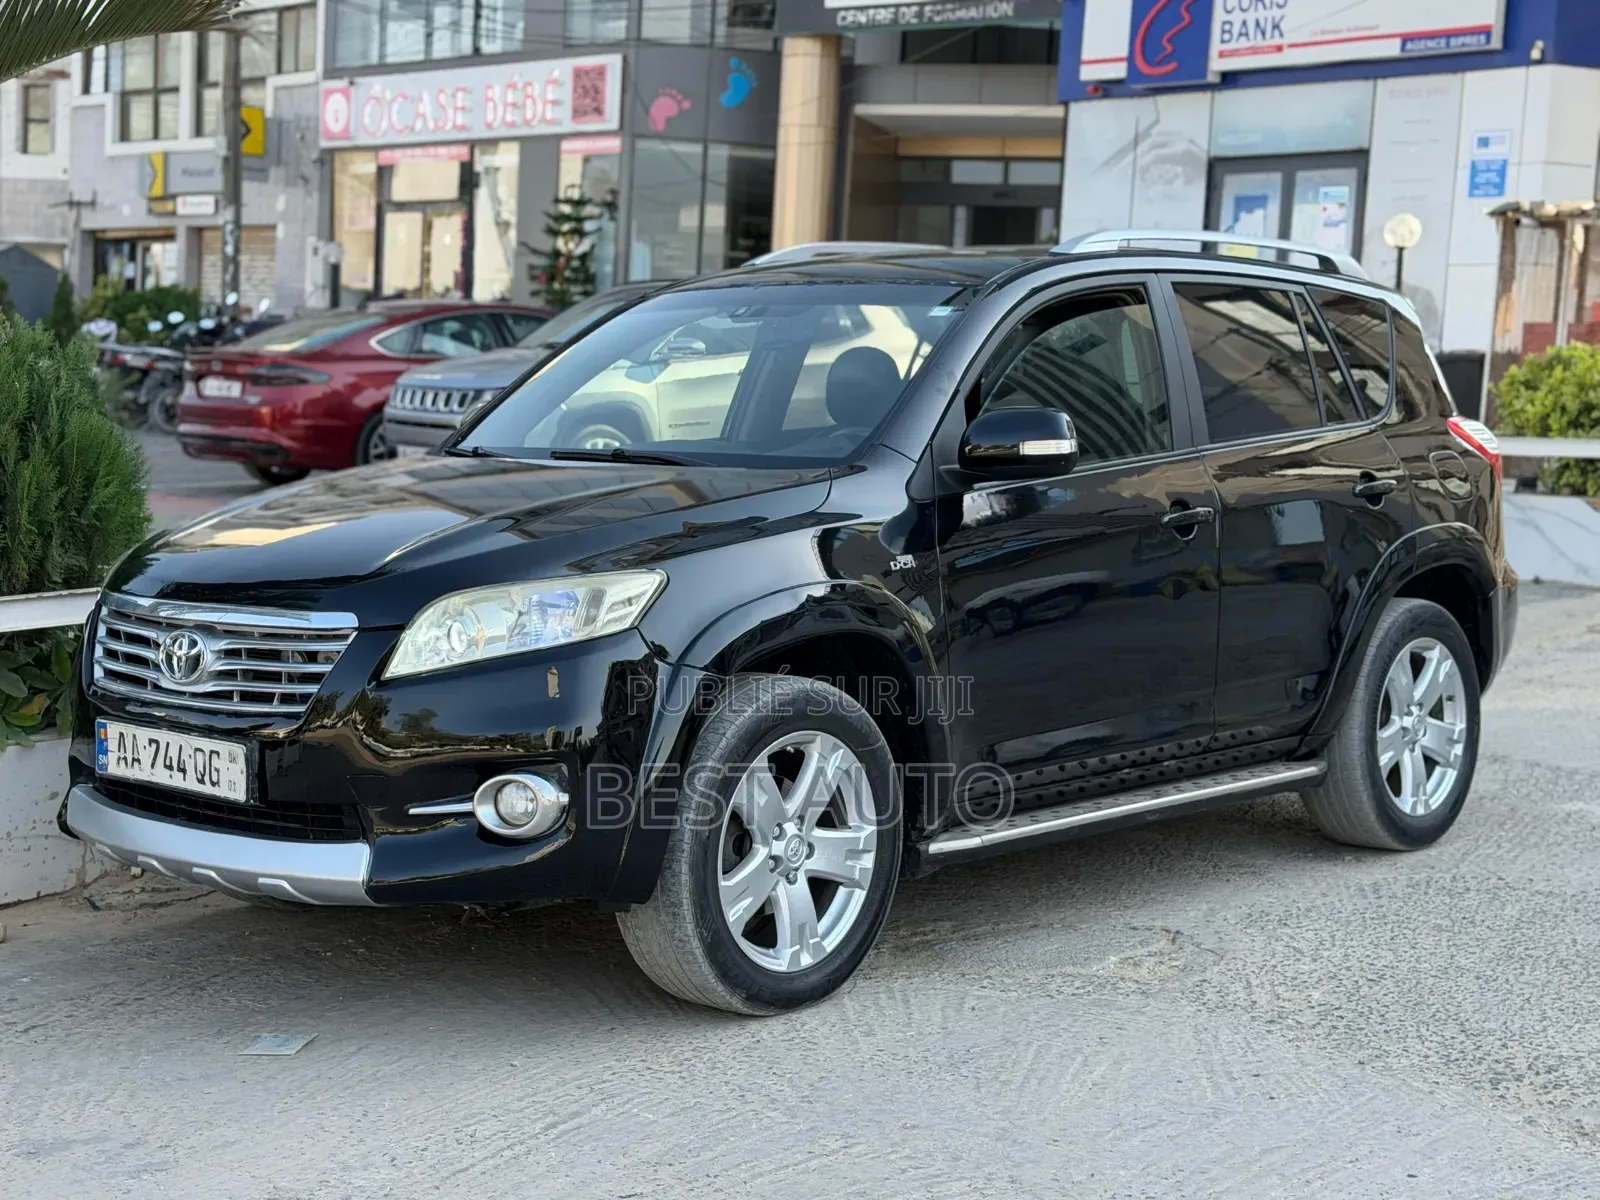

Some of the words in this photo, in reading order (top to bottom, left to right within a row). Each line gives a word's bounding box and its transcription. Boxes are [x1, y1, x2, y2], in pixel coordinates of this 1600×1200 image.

[836, 8, 896, 27] CENTRE
[900, 6, 920, 24] DE
[923, 1, 1014, 22] FORMATION
[1220, 14, 1285, 44] BANK
[1404, 36, 1446, 50] AGENCE
[484, 68, 565, 130] BÉBÉ
[193, 746, 221, 788] QG
